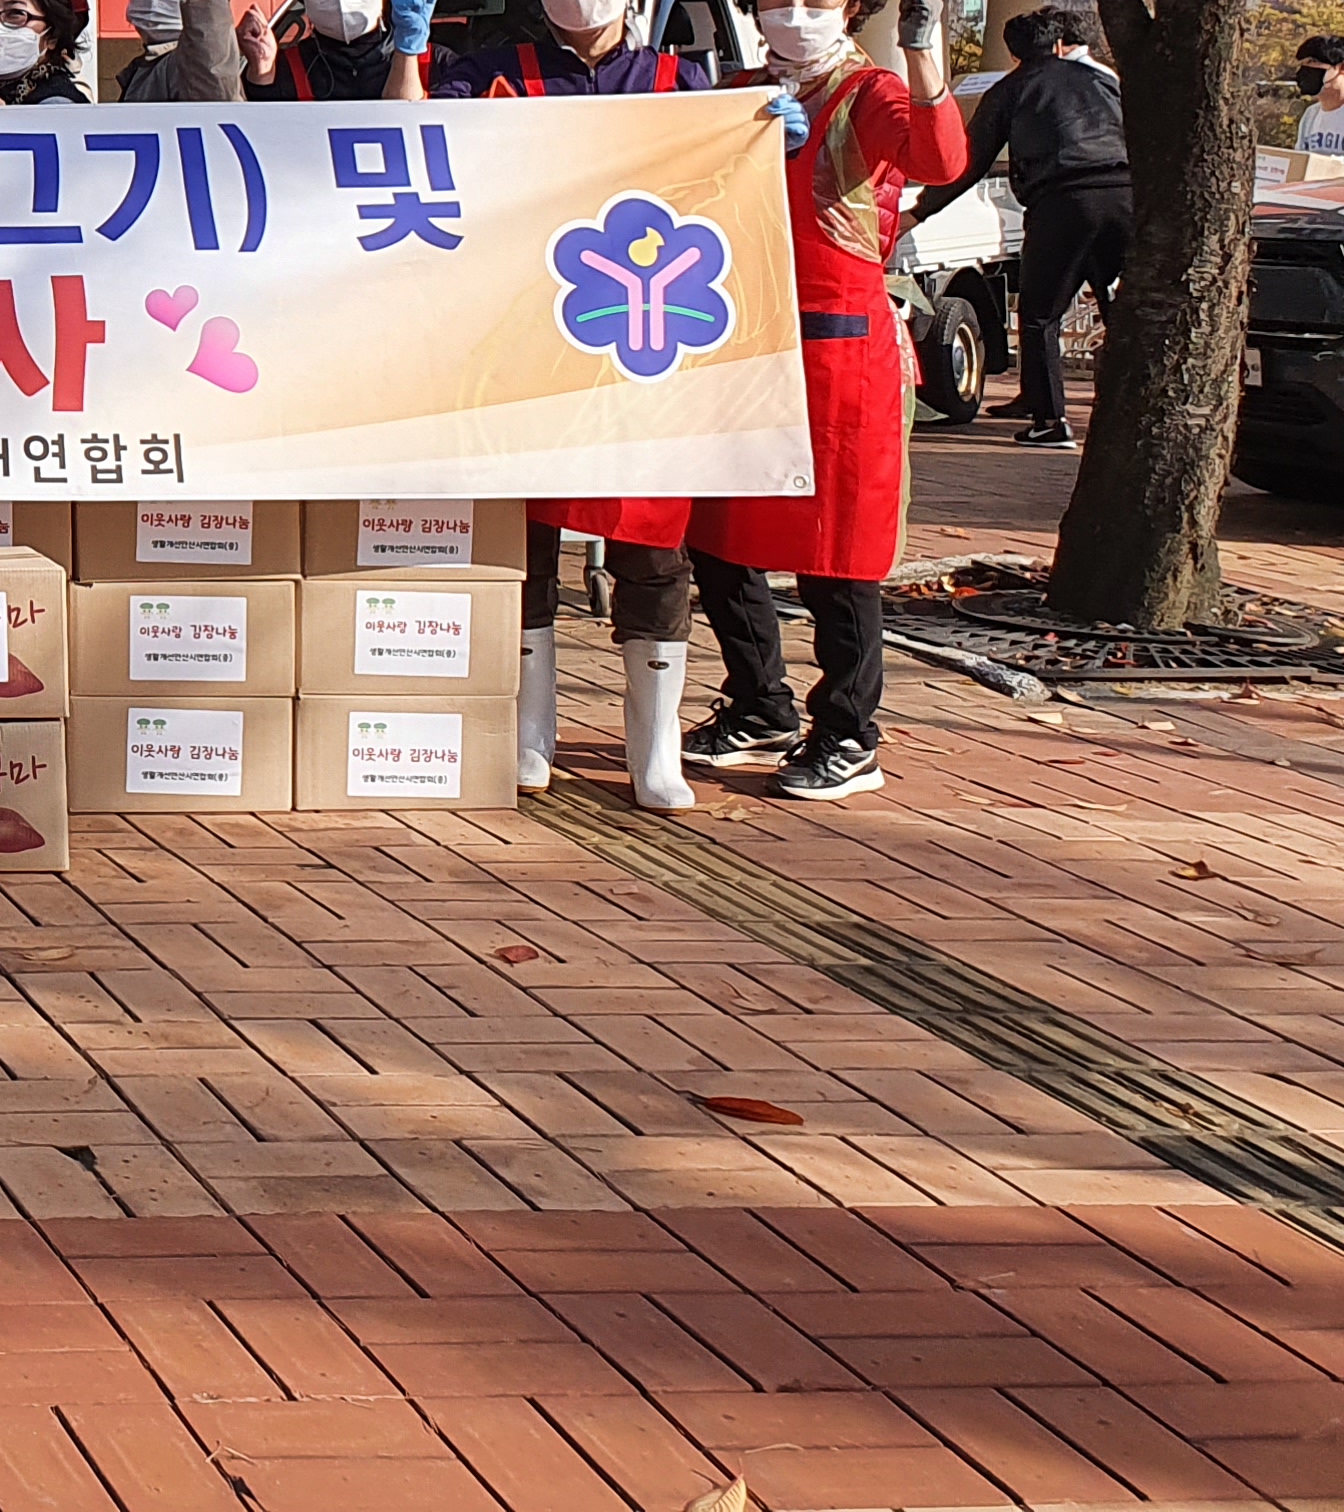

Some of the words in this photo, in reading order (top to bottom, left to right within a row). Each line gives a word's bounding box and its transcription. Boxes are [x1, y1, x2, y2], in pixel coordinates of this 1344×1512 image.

[327, 124, 465, 252] 및
[141, 512, 192, 528] 이웃사랑
[200, 514, 250, 530] 김장나눔
[362, 518, 413, 533] 이웃사랑
[421, 518, 470, 534] 김장나눔
[139, 625, 182, 639] 이웃사랑
[190, 624, 238, 639] 김장나눔
[365, 620, 407, 634] 이웃사랑
[415, 620, 462, 636] 김장나눔
[131, 743, 181, 759] 이웃사랑
[189, 745, 239, 760] 김장나눔
[352, 747, 402, 762] 이웃사랑
[409, 748, 458, 763] 김장나눔
